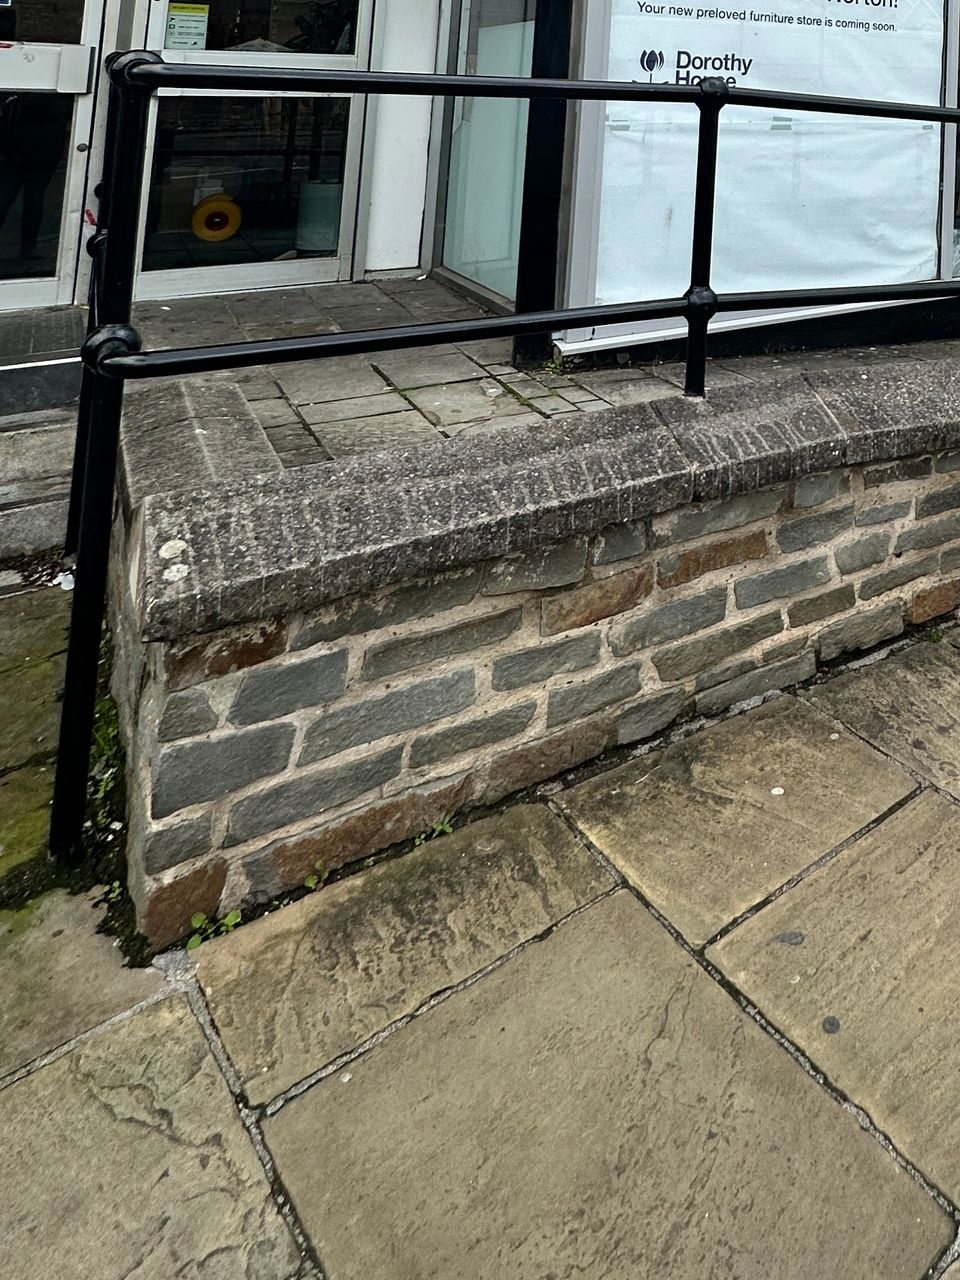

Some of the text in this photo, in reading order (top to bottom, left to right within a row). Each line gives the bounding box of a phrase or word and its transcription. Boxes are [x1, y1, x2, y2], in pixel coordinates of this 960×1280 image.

[637, 1, 898, 33] Your new preloved furniture store is coming soon.
[676, 50, 753, 75] Dorothy
[675, 70, 737, 89] Hoe
